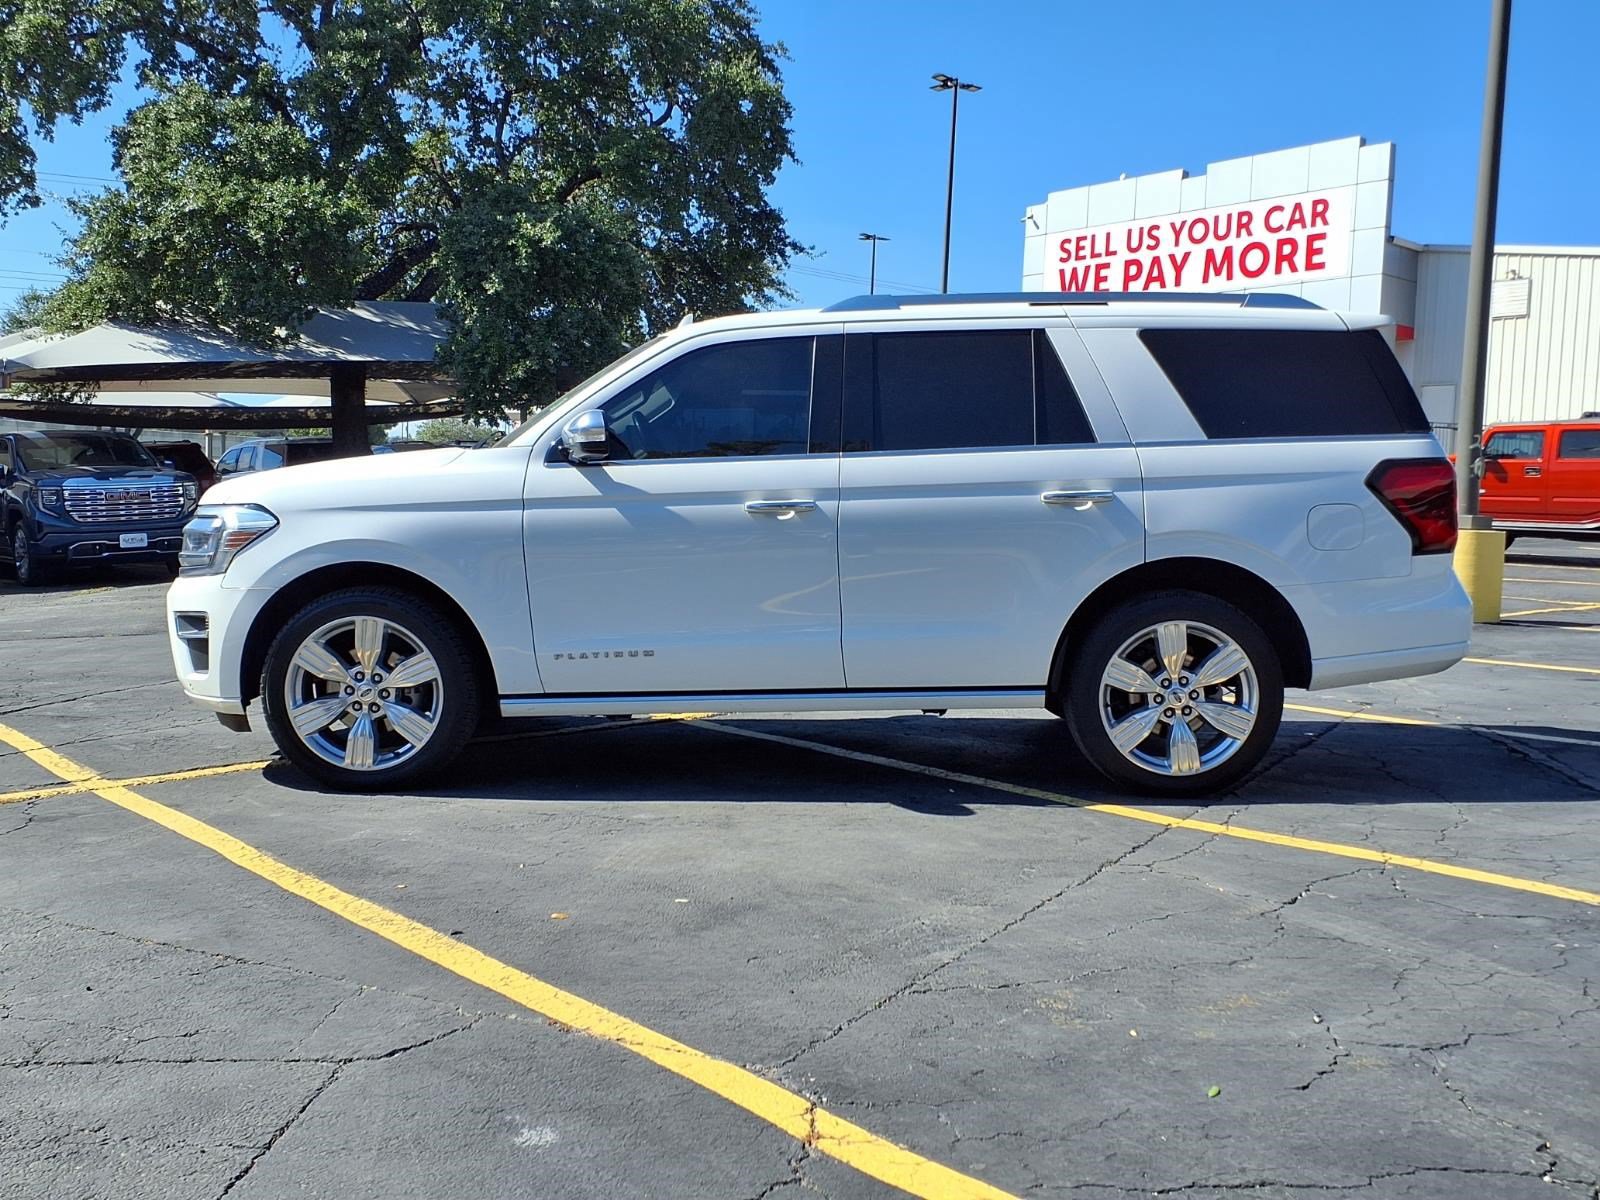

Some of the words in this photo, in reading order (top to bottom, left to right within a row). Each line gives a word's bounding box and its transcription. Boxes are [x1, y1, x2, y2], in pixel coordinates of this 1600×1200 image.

[1059, 232, 1117, 263] SELL
[1126, 225, 1161, 253] US
[1170, 210, 1253, 247] YOUR
[1264, 199, 1329, 234] CAR
[1059, 263, 1111, 293] WE
[1122, 251, 1192, 293] PAY
[1202, 233, 1327, 284] MORE
[106, 491, 150, 501] GMC
[553, 649, 655, 660] PLATINUM
